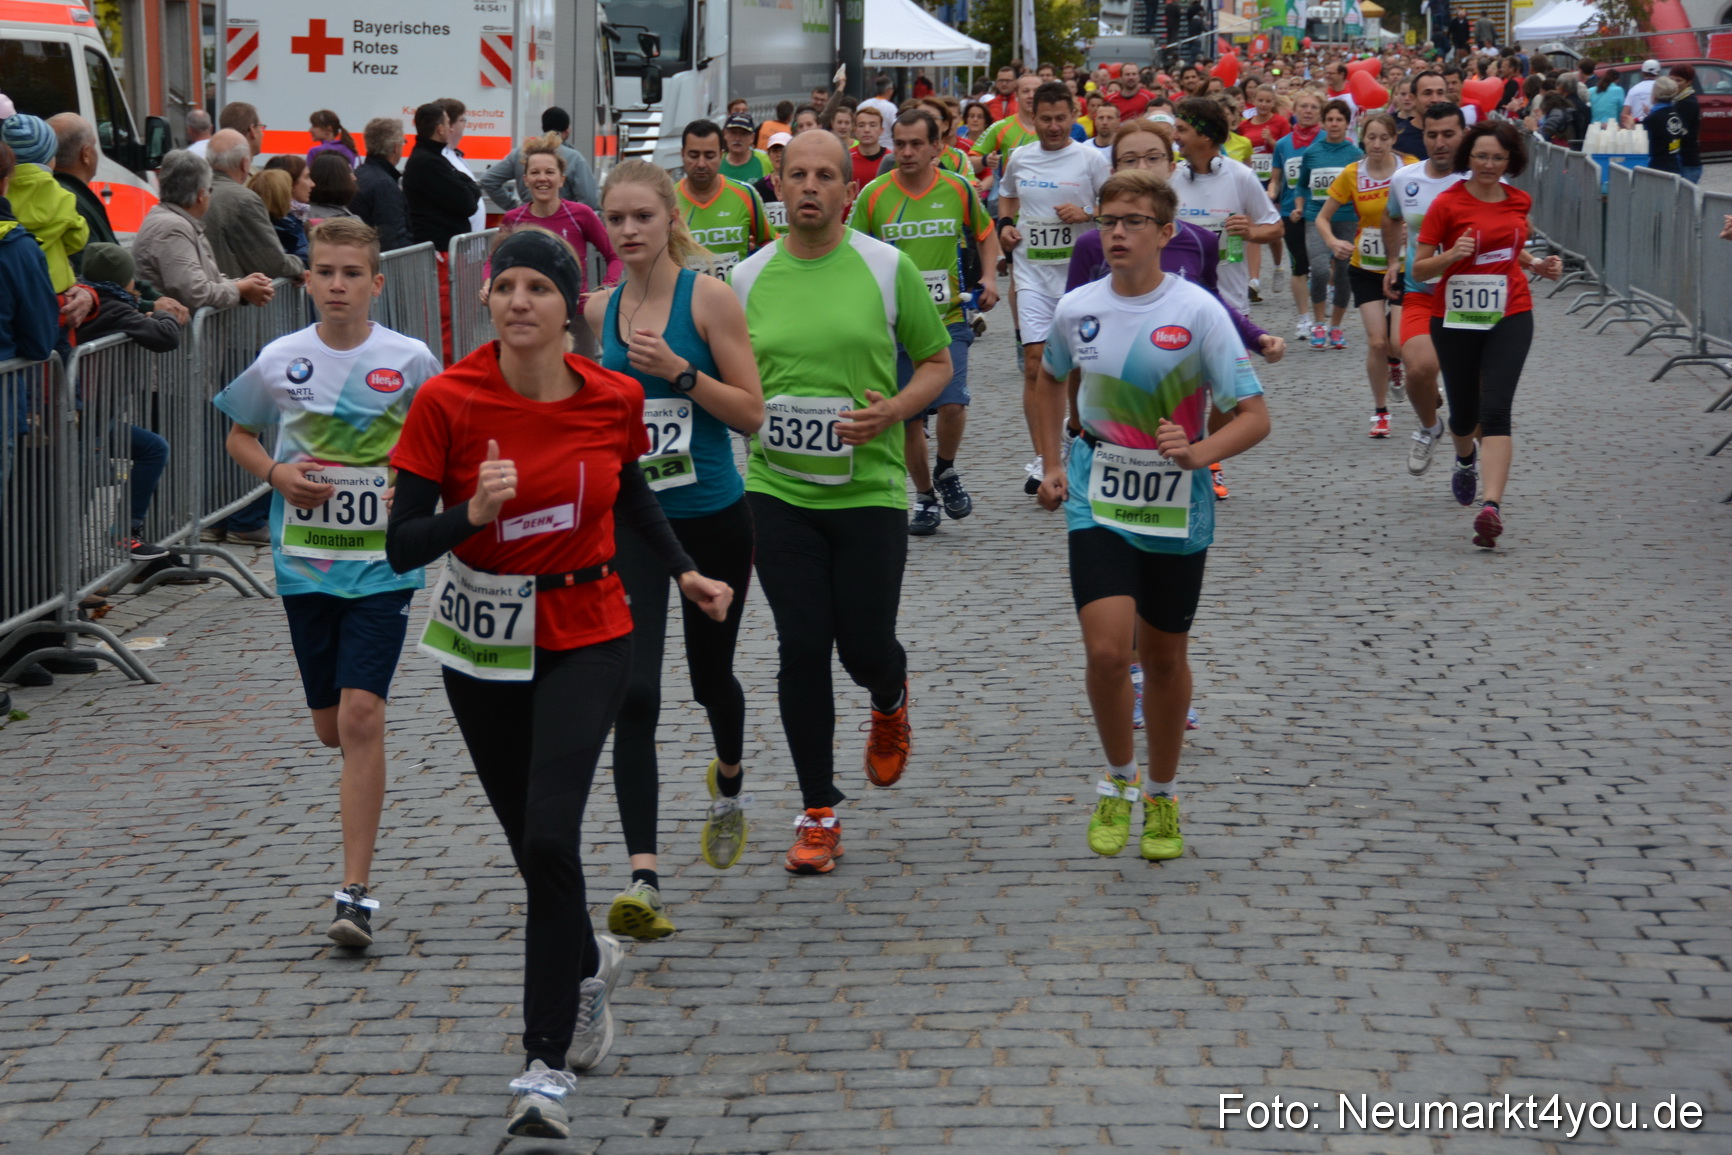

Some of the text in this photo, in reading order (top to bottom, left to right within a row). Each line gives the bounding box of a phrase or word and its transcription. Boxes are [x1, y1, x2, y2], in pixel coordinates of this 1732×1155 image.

[353, 19, 450, 36] Bayerisches
[353, 40, 398, 55] Rotes
[869, 49, 934, 61] Laufsport
[353, 61, 399, 75] Kreuz
[1358, 193, 1380, 202] MAX
[690, 227, 743, 246] OCK
[882, 219, 956, 241] BOCK
[1030, 227, 1072, 246] 5178
[1452, 288, 1499, 308] 5101
[1156, 331, 1187, 343] Hervis
[371, 373, 400, 386] Hervis
[645, 408, 673, 417] markt
[765, 403, 836, 415] ARTL Neumarkt
[642, 423, 682, 456] 02
[769, 415, 843, 452] 5320
[1096, 450, 1126, 464] PARTL
[321, 475, 369, 486] Neumarkt
[1101, 466, 1182, 502] 5007
[523, 515, 554, 530] DEHN
[1114, 508, 1160, 524] Florian
[304, 531, 365, 547] Jonathan
[461, 577, 512, 597] Neumarkt
[440, 581, 523, 639] 5067
